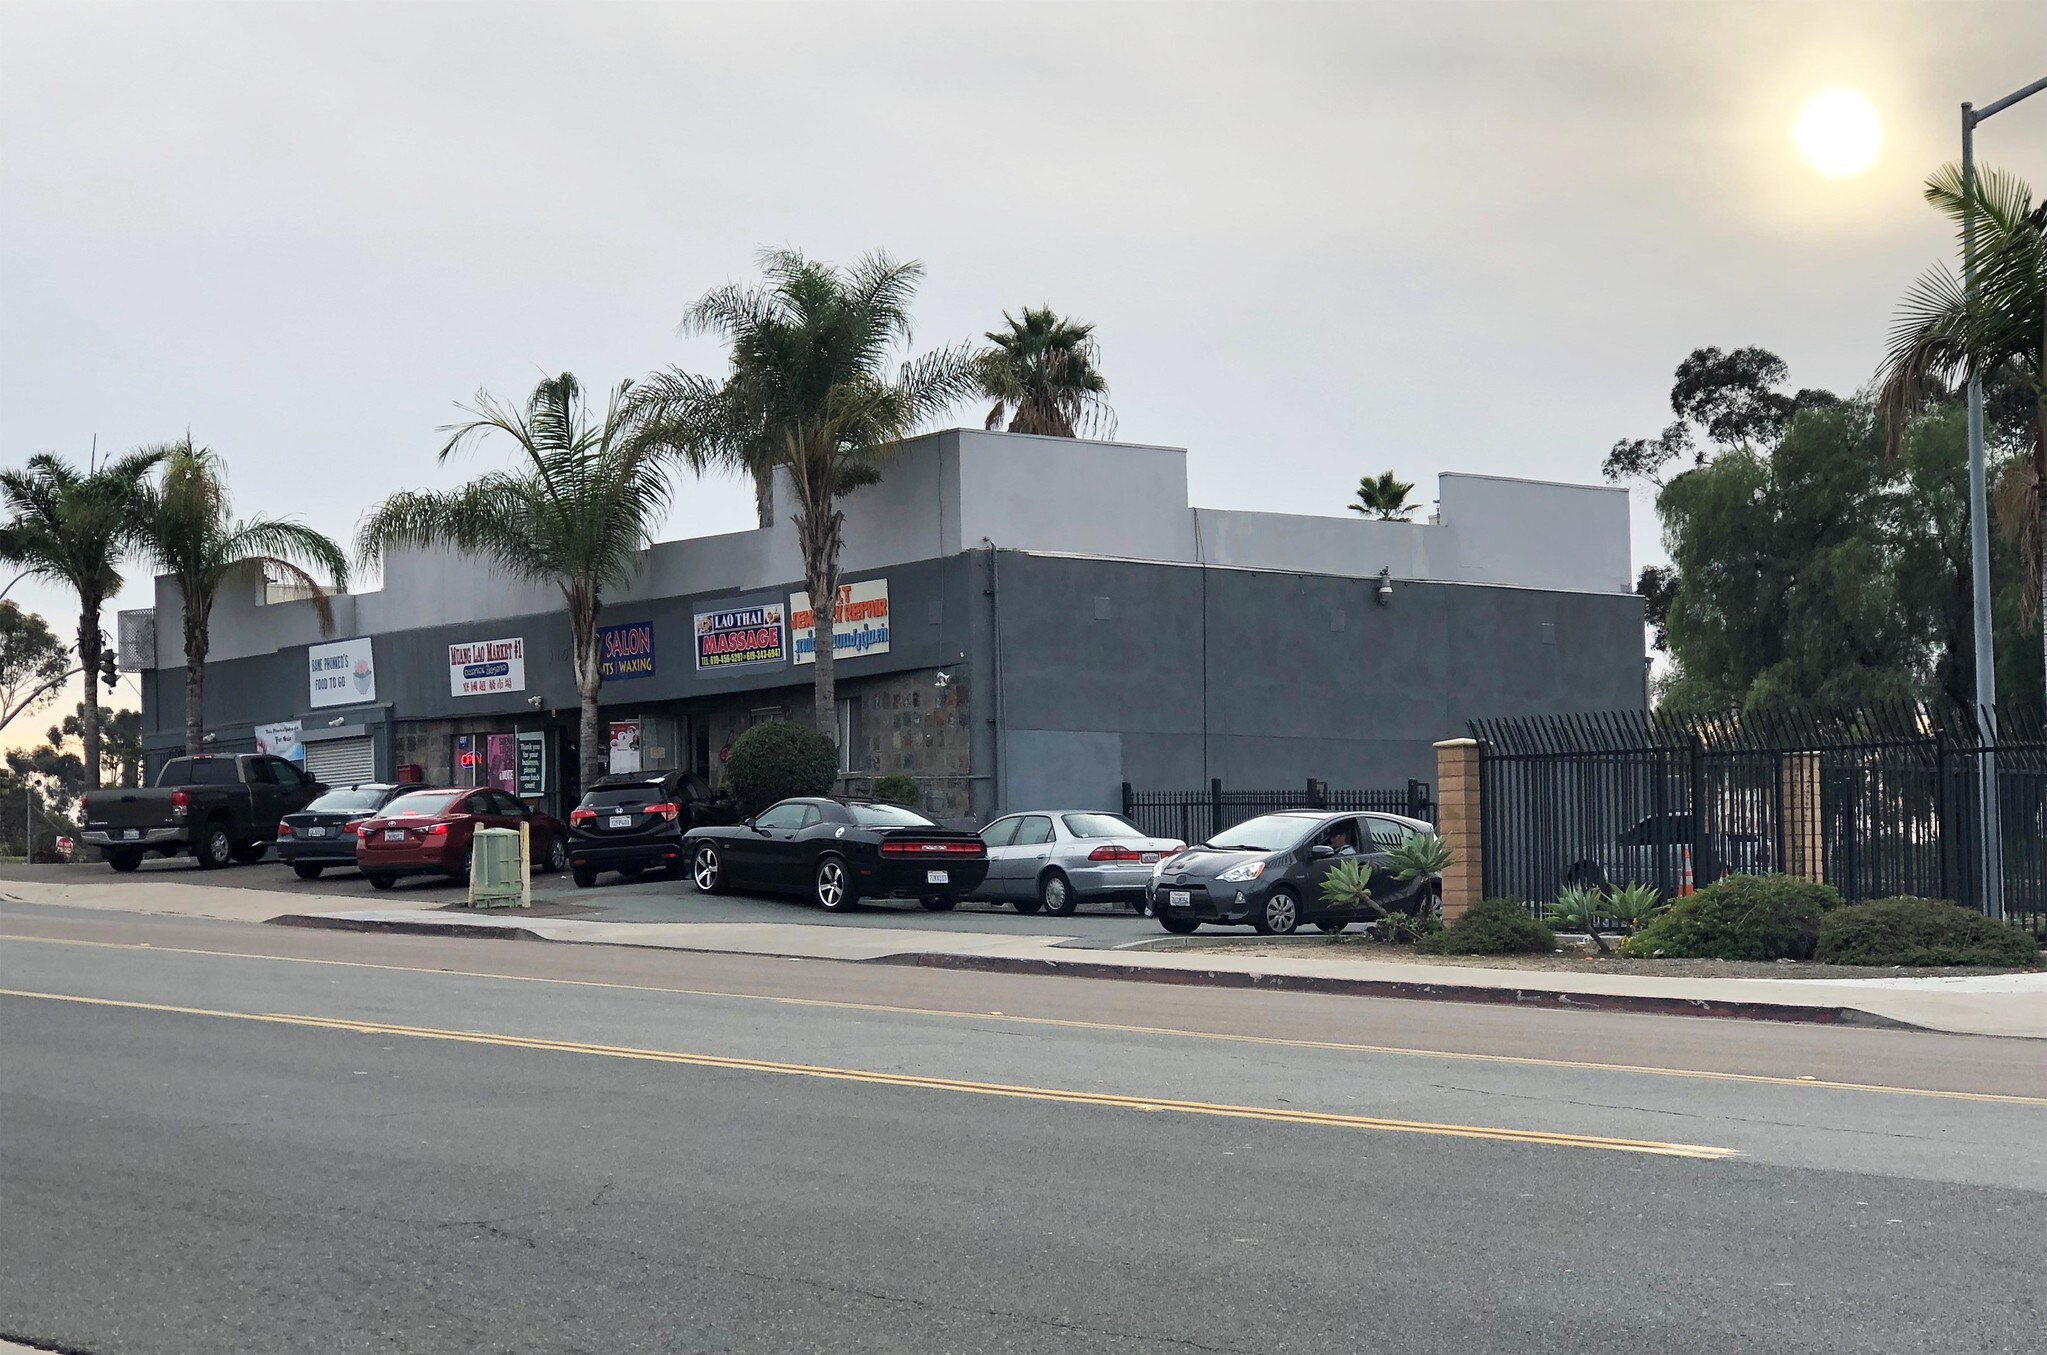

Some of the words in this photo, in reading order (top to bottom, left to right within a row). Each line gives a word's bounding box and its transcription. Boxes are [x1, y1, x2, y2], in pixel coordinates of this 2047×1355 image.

[714, 613, 734, 629] LAO
[735, 610, 762, 626] THAI
[844, 598, 887, 622] REPAIR
[472, 644, 485, 663] LAO
[486, 642, 513, 662] MARKET
[514, 639, 522, 659] #1
[605, 627, 650, 658] SALON
[702, 627, 779, 655] MASSAGE
[618, 657, 652, 673] WAXING
[315, 678, 328, 690] FOOD
[329, 677, 337, 688] TO
[338, 676, 346, 687] GO
[520, 743, 532, 751] Thank
